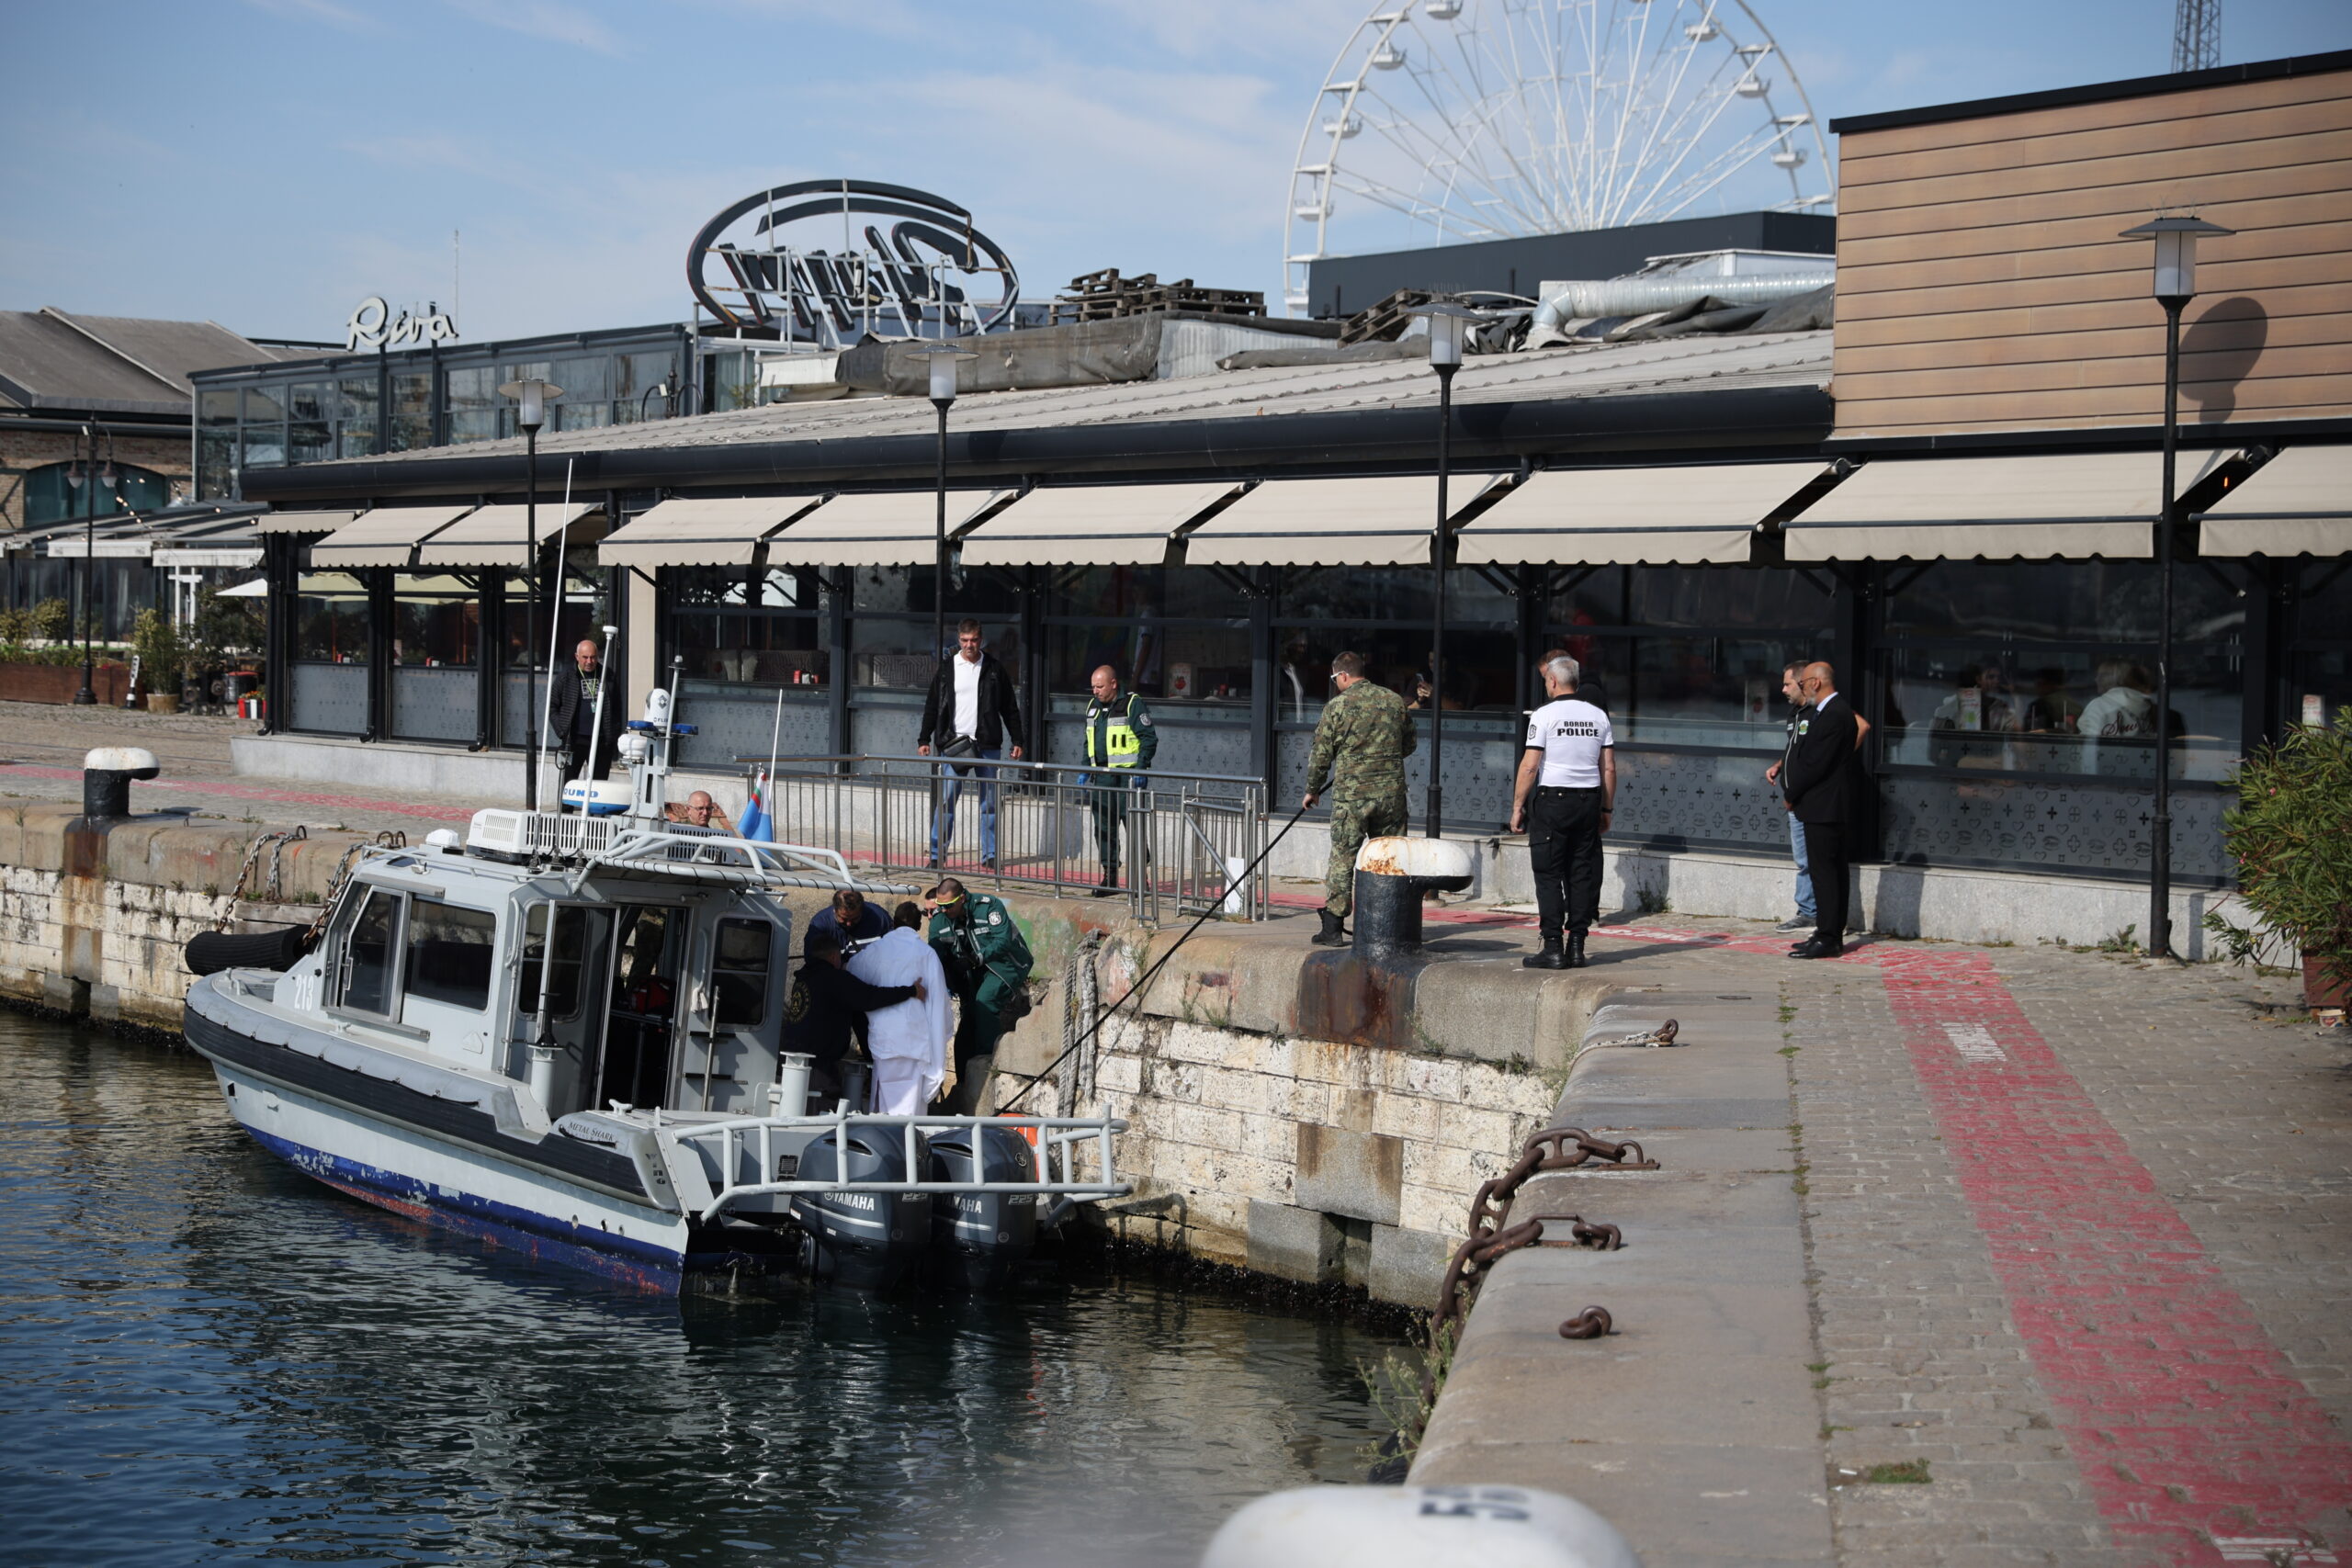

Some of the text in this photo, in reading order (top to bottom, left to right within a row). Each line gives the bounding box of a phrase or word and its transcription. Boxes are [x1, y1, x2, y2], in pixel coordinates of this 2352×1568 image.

[346, 296, 459, 352] Riva
[1556, 728, 1600, 738] POLICE
[294, 974, 314, 1011] 213
[569, 1122, 589, 1134] METAL
[591, 1128, 613, 1141] SHARK
[834, 1192, 875, 1212] YAMAHA
[1008, 1192, 1035, 1206] 225
